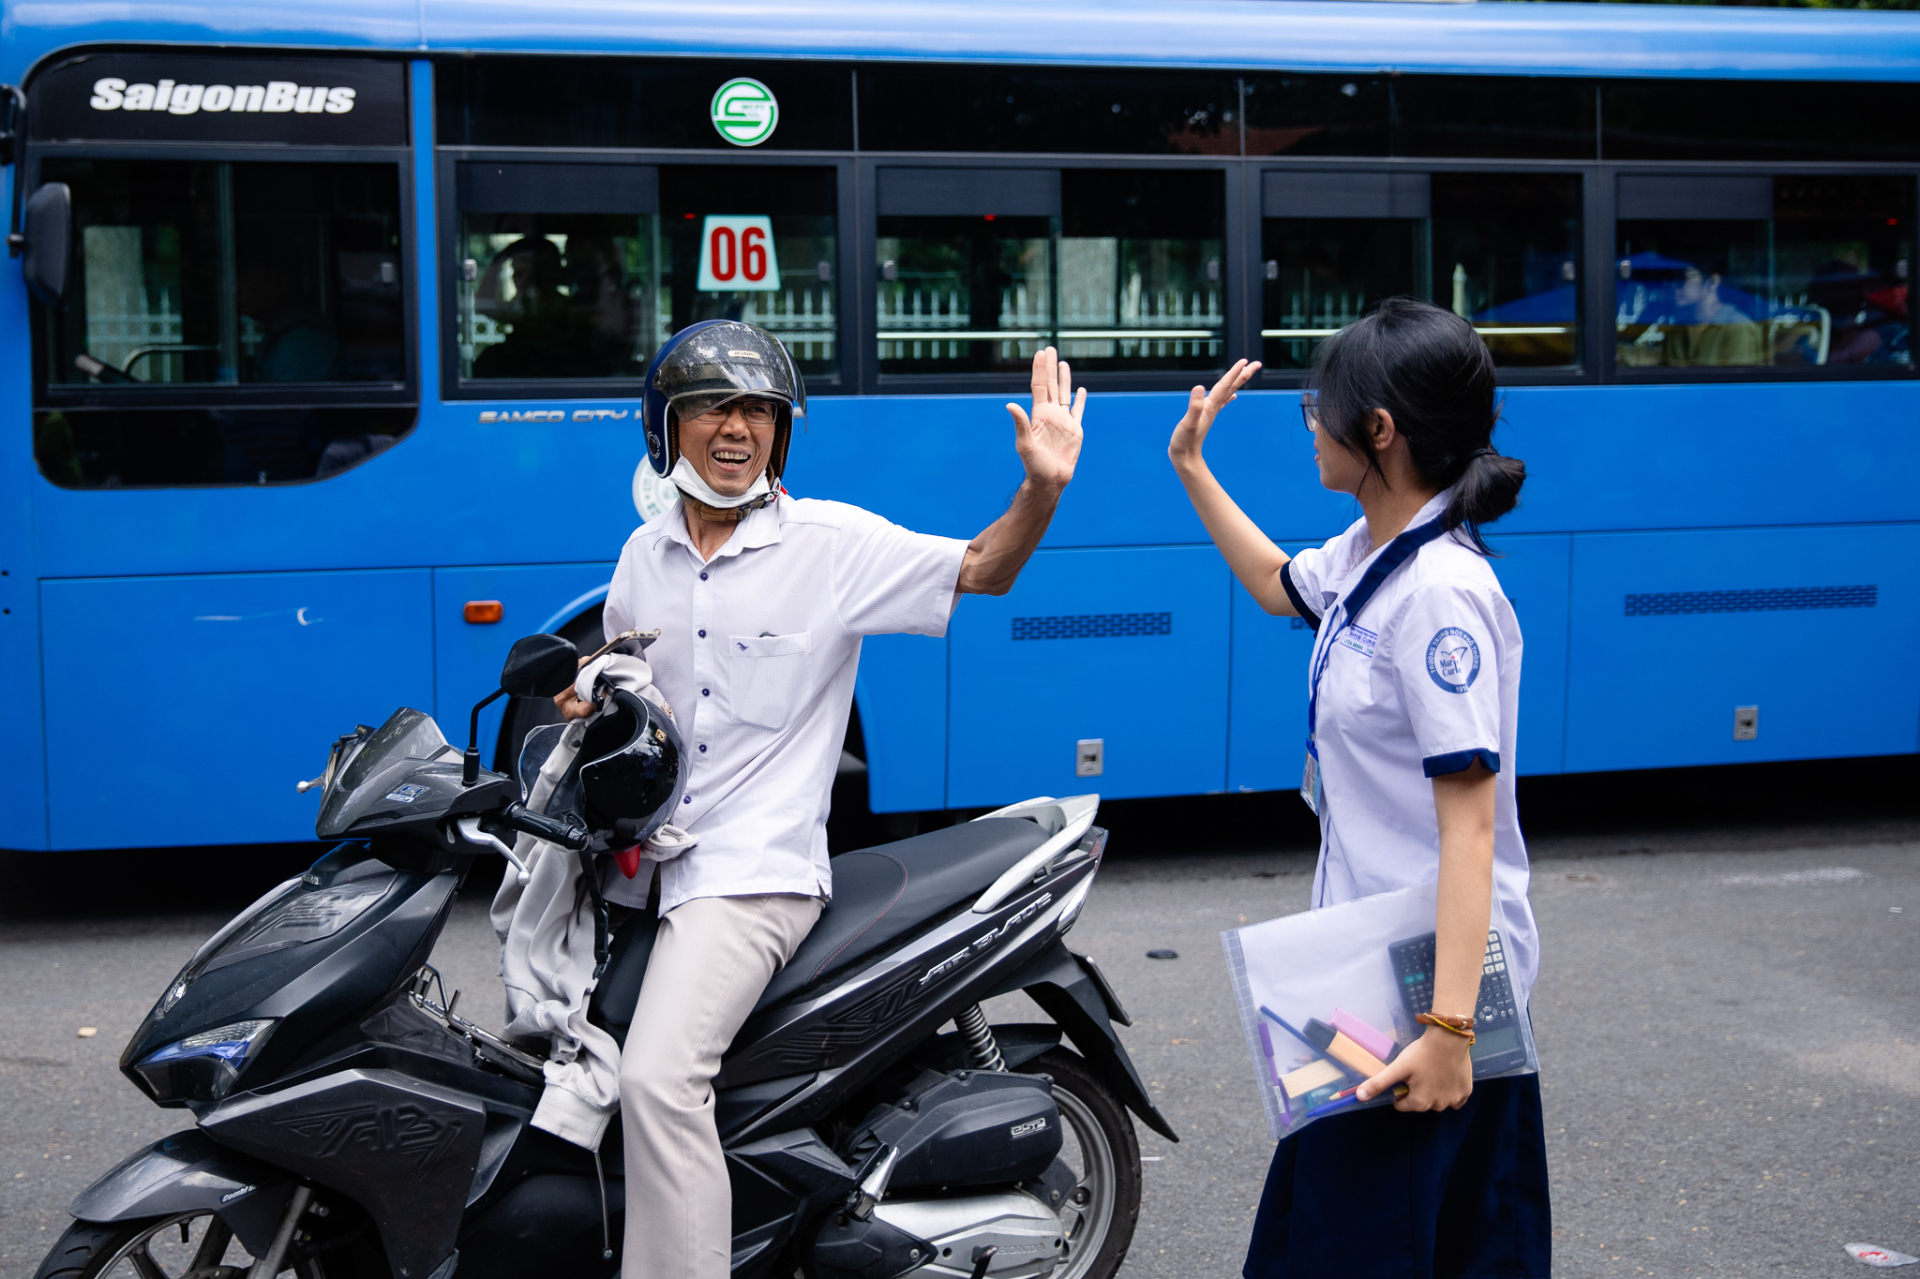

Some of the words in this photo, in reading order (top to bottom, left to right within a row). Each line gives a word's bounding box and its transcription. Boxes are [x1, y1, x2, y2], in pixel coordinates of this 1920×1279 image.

[90, 77, 356, 114] SaigonBus
[711, 226, 767, 282] 06
[478, 410, 565, 424] SAMCO
[572, 409, 628, 422] CITY
[919, 946, 971, 985] AIR
[972, 892, 1053, 950] BLADE
[996, 1242, 1047, 1255] HONDA
